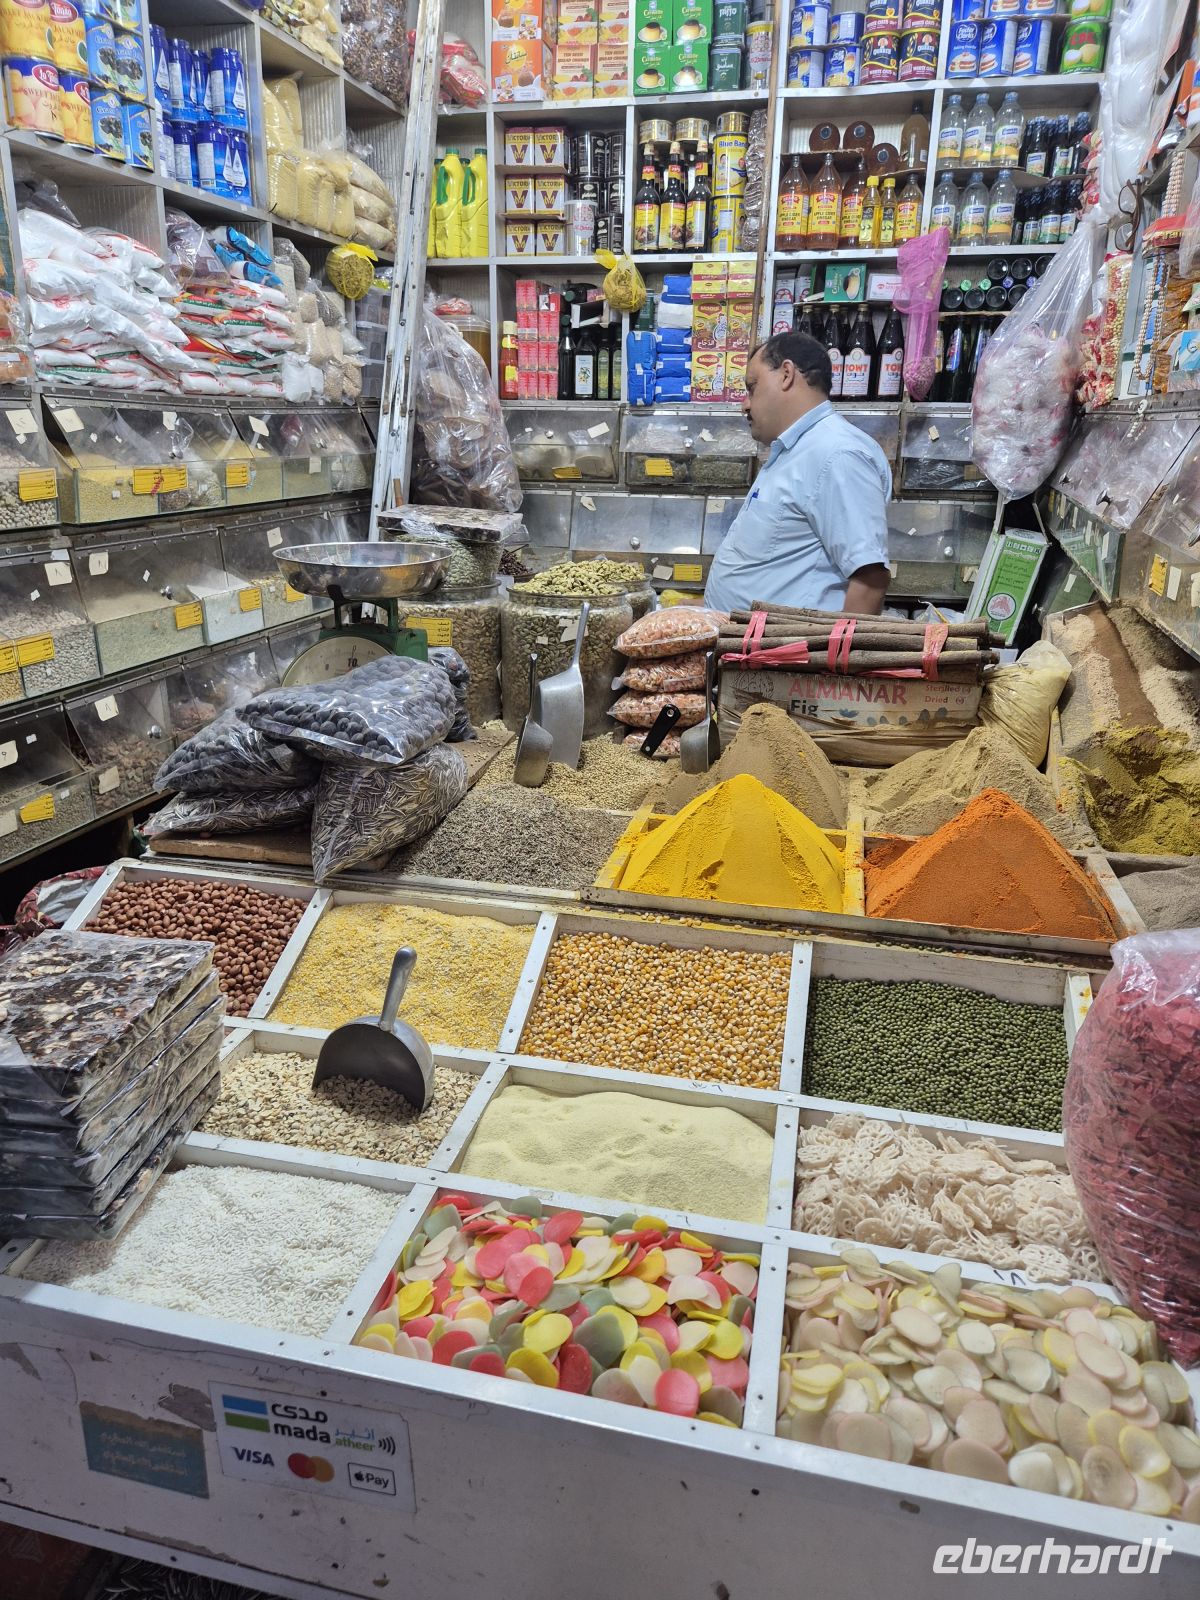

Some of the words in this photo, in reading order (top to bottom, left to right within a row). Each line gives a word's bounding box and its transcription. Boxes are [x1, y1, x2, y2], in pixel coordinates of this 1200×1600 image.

[788, 678, 908, 705] ALMANAR
[790, 700, 818, 717] Fig
[271, 1403, 328, 1423] مدى
[274, 1422, 331, 1443] mada
[336, 1437, 375, 1452] atheer
[233, 1447, 275, 1467] VISA
[366, 1474, 389, 1489] Pay
